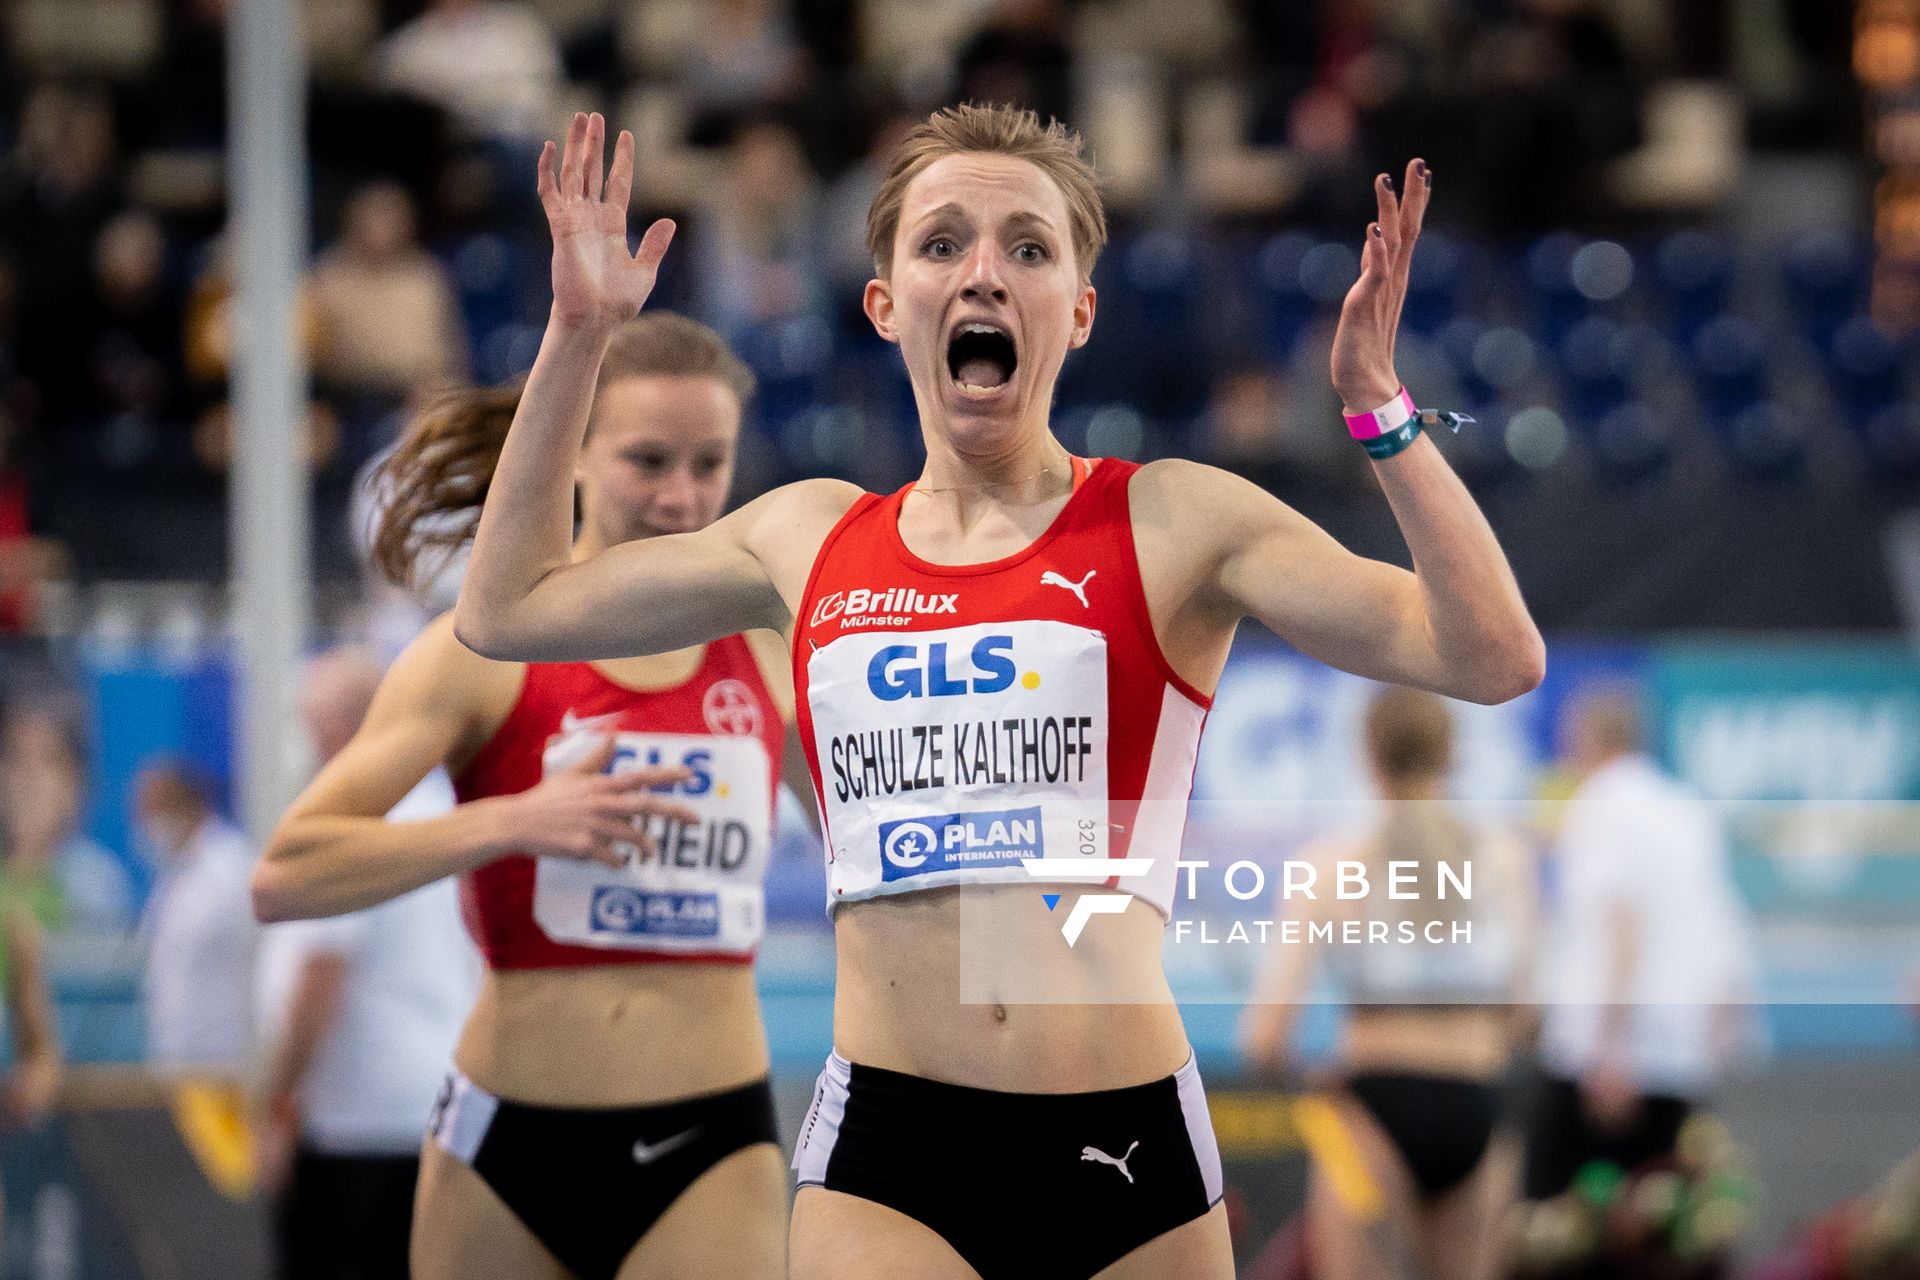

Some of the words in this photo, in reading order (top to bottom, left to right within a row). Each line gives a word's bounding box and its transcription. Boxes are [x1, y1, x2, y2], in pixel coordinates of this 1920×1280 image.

[844, 588, 959, 614] Brillux
[840, 615, 912, 629] Münster
[831, 724, 944, 803] SCHULZE
[954, 715, 1092, 786] KALTHOFF
[944, 819, 1036, 849] PLAN
[1078, 819, 1096, 856] 320
[945, 850, 1036, 862] INTERNATIONAL
